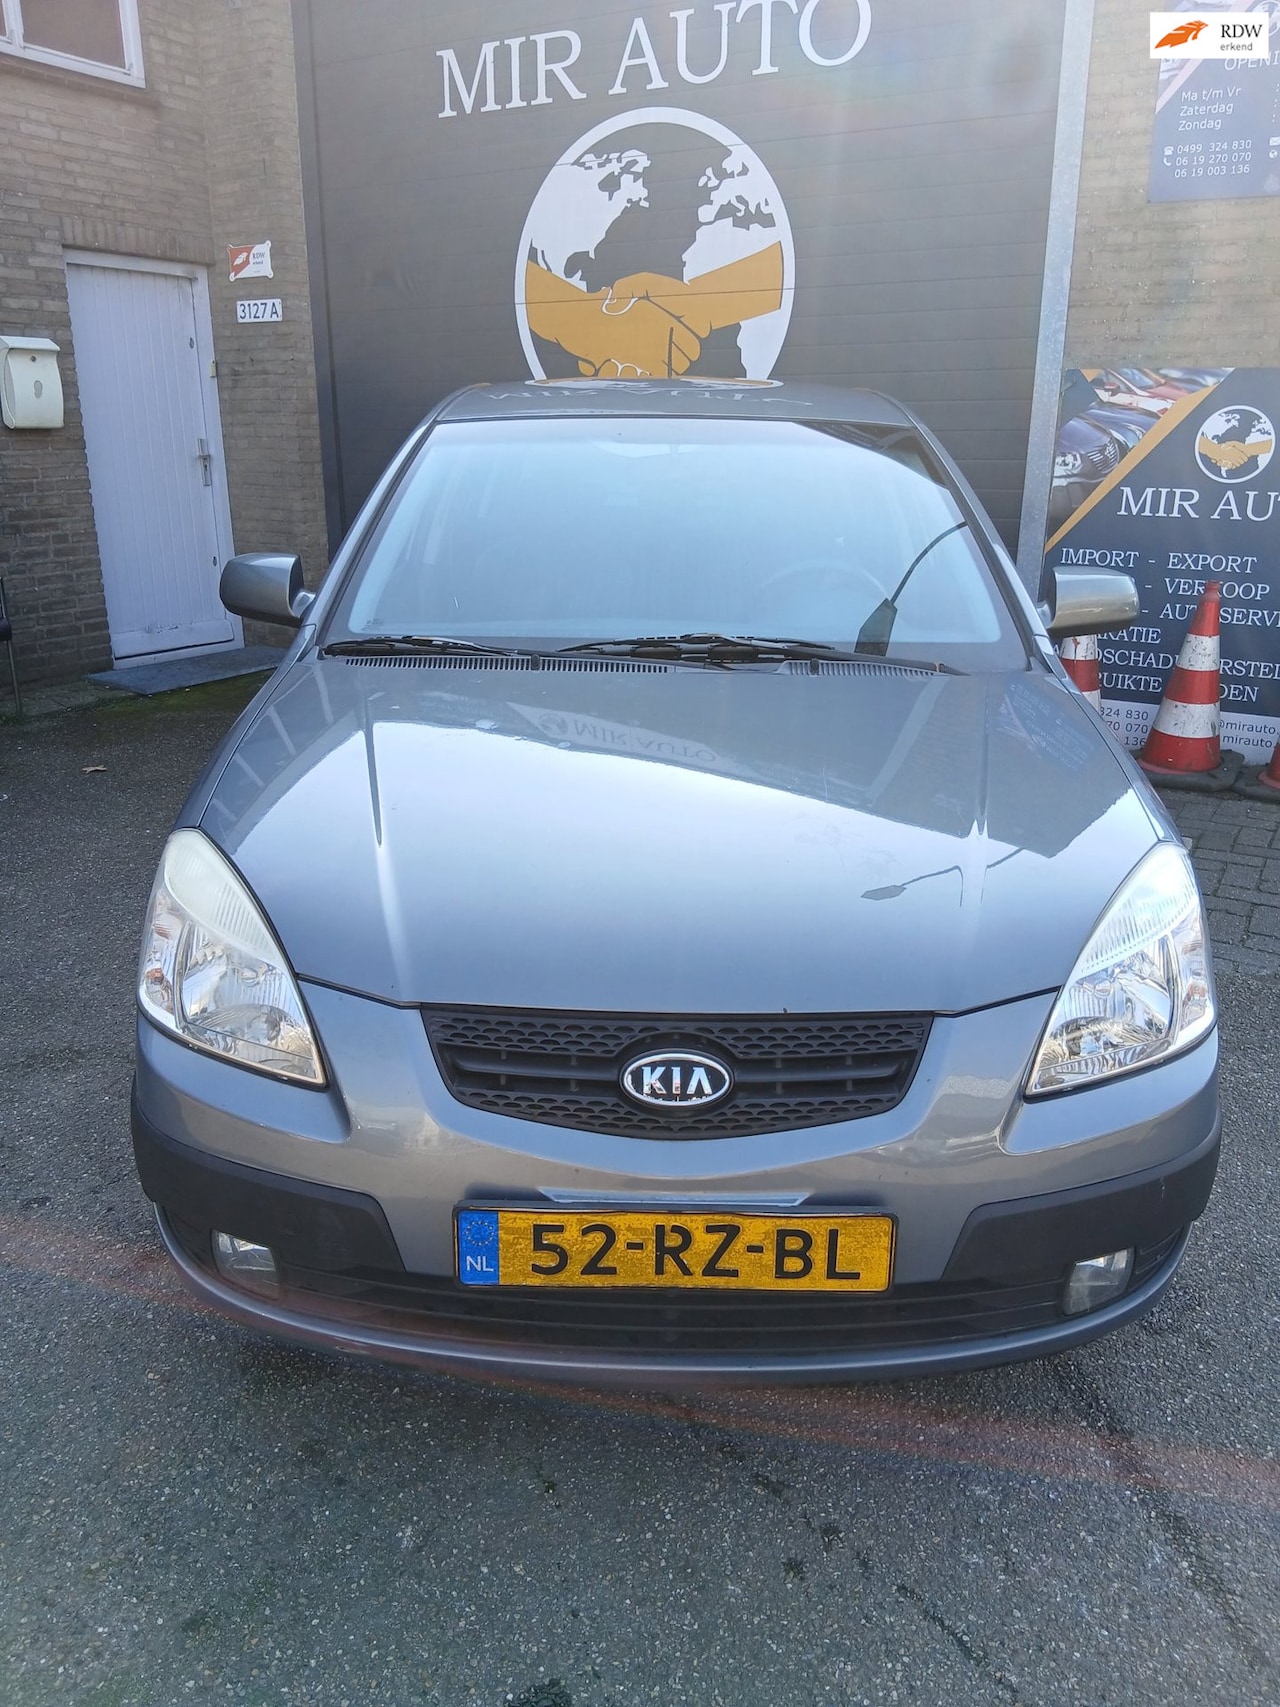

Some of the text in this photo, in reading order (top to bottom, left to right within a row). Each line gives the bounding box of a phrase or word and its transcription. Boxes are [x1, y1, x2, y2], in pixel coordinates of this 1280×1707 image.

[436, 0, 872, 118] MIR AUTO
[1181, 91, 1198, 102] Ma
[1202, 88, 1223, 101] t/m
[1227, 86, 1242, 100] Vr
[1180, 103, 1234, 117] Zaterdag
[1178, 119, 1222, 131] Zondag
[1177, 139, 1252, 154] 0499 324 830
[1175, 152, 1252, 166] 06 19 270 070
[1174, 164, 1250, 178] 06 19 003 136
[1117, 486, 1280, 522] MIR AU
[1060, 547, 1140, 568] IMPORT
[1167, 552, 1258, 575] EXPORT
[1164, 577, 1270, 600] VEROOP
[1099, 671, 1163, 693] UIKTE
[1125, 709, 1149, 721] 830
[1125, 723, 1149, 734] 070
[642, 1066, 713, 1095] KIA
[465, 1223, 861, 1280] NL 52-RZ-BL
